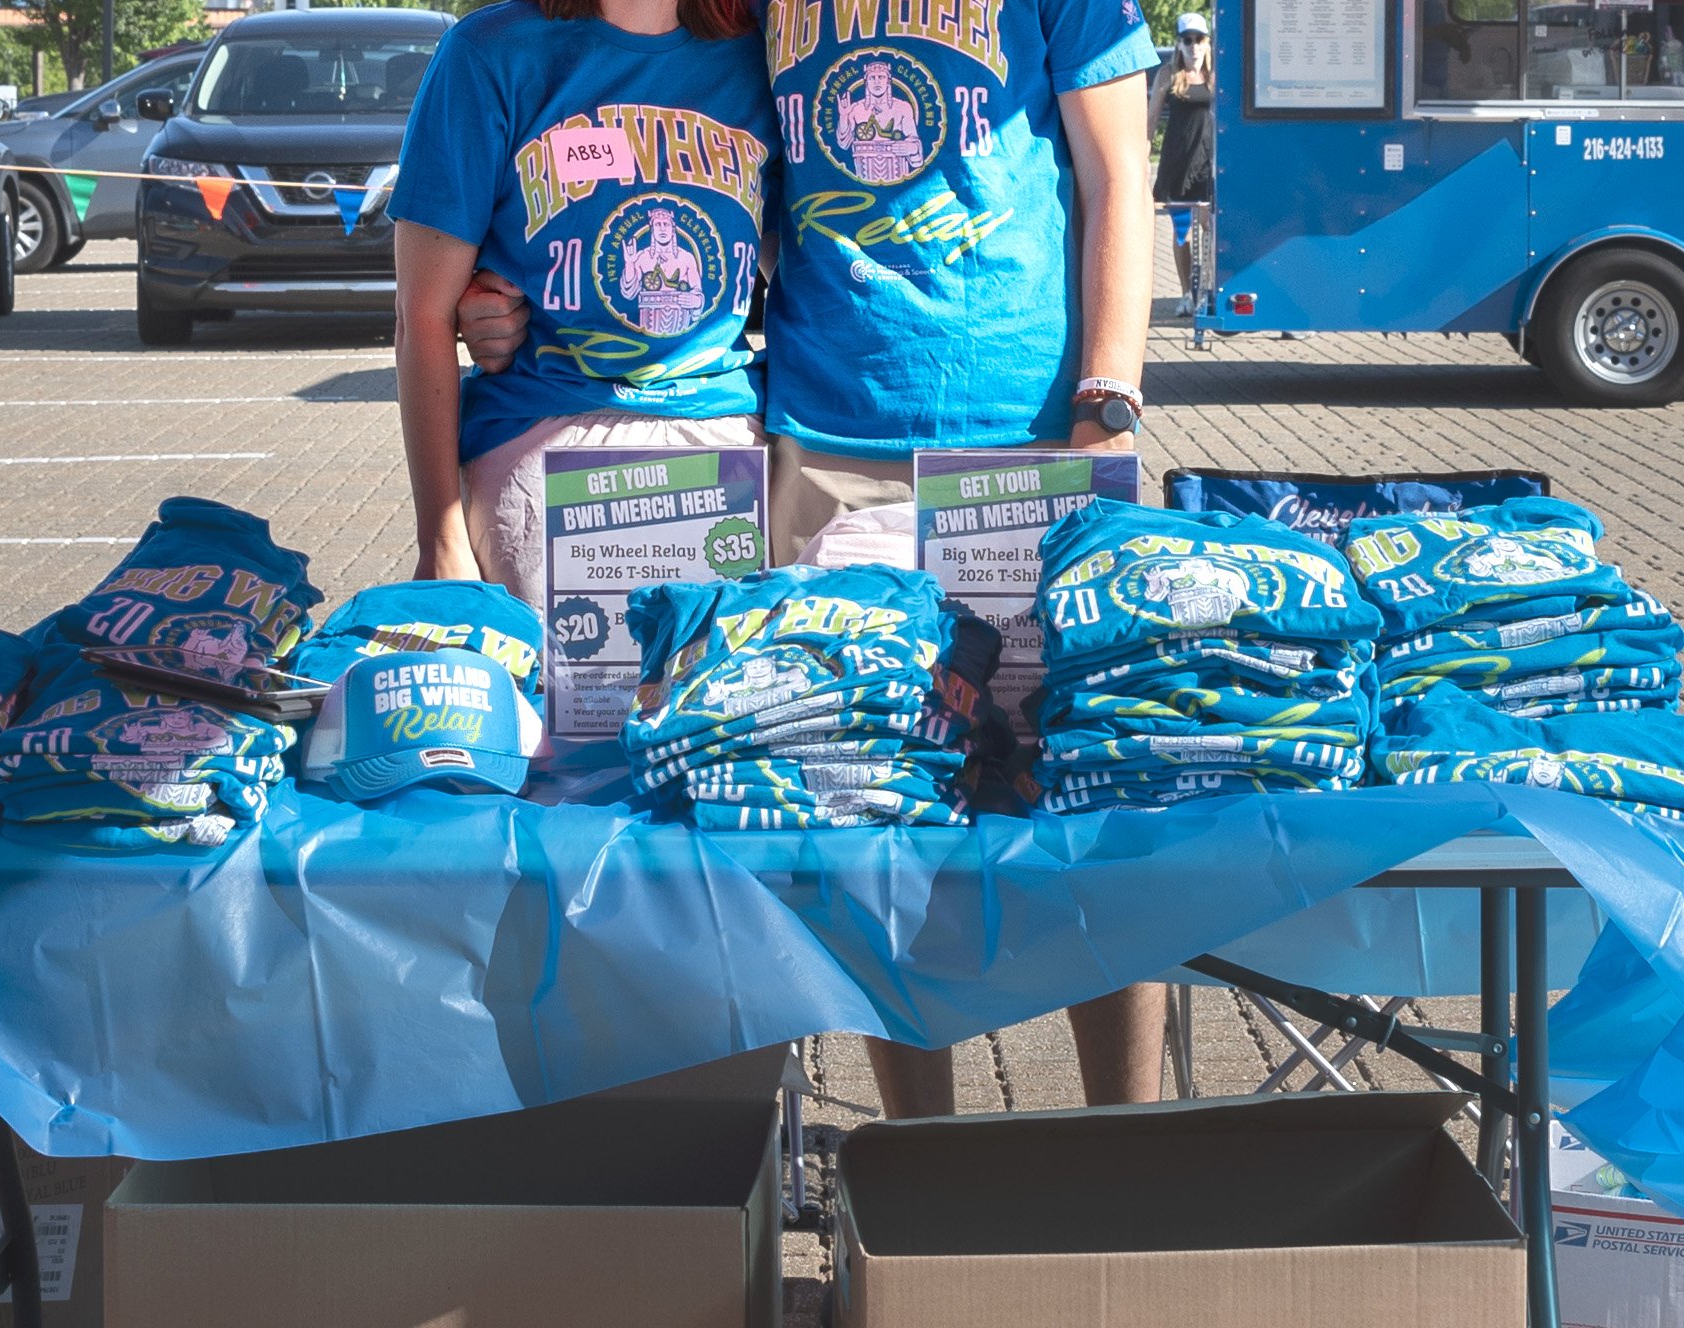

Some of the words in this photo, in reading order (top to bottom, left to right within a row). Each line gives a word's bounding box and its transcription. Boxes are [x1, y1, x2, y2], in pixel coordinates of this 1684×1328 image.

[954, 86, 994, 157] 26
[1583, 136, 1664, 161] 216-424-4133
[791, 190, 1015, 266] Relay
[543, 238, 583, 312] 20
[587, 469, 619, 495] GET
[621, 463, 669, 491] YOUR
[959, 475, 991, 499] GET
[994, 469, 1042, 495] YOUR
[562, 504, 607, 532] BWR
[610, 495, 677, 527] MERCH
[681, 487, 728, 516] HERE
[934, 510, 978, 535] BWR
[982, 501, 1049, 529] MERCH
[570, 544, 596, 562] Big
[599, 544, 648, 559] Wheel
[651, 544, 696, 561] Relay
[711, 532, 757, 565] $35
[941, 547, 968, 565] Big
[970, 547, 1020, 562] Wheel
[93, 565, 225, 602] BIG
[587, 565, 623, 580] 2026
[626, 565, 682, 580] T-Shirt
[957, 568, 994, 583] 2026
[998, 568, 1044, 583] T-Shir
[1377, 573, 1435, 603] 20
[86, 597, 155, 646] 20
[1049, 587, 1102, 630] 20
[555, 612, 599, 645] $20
[1001, 635, 1045, 649] Truck
[373, 663, 492, 691] CLEVELAND
[573, 671, 621, 680] Pre-ordered
[623, 671, 641, 680] shir
[374, 688, 413, 715] BIG
[420, 686, 493, 713] WHEEL
[573, 708, 594, 716] Wear
[596, 710, 616, 718] your
[383, 705, 485, 743] Relay
[54, 1175, 88, 1197] BLUE
[1592, 1239, 1640, 1254] POSTAL
[1596, 1225, 1645, 1240] UNITED
